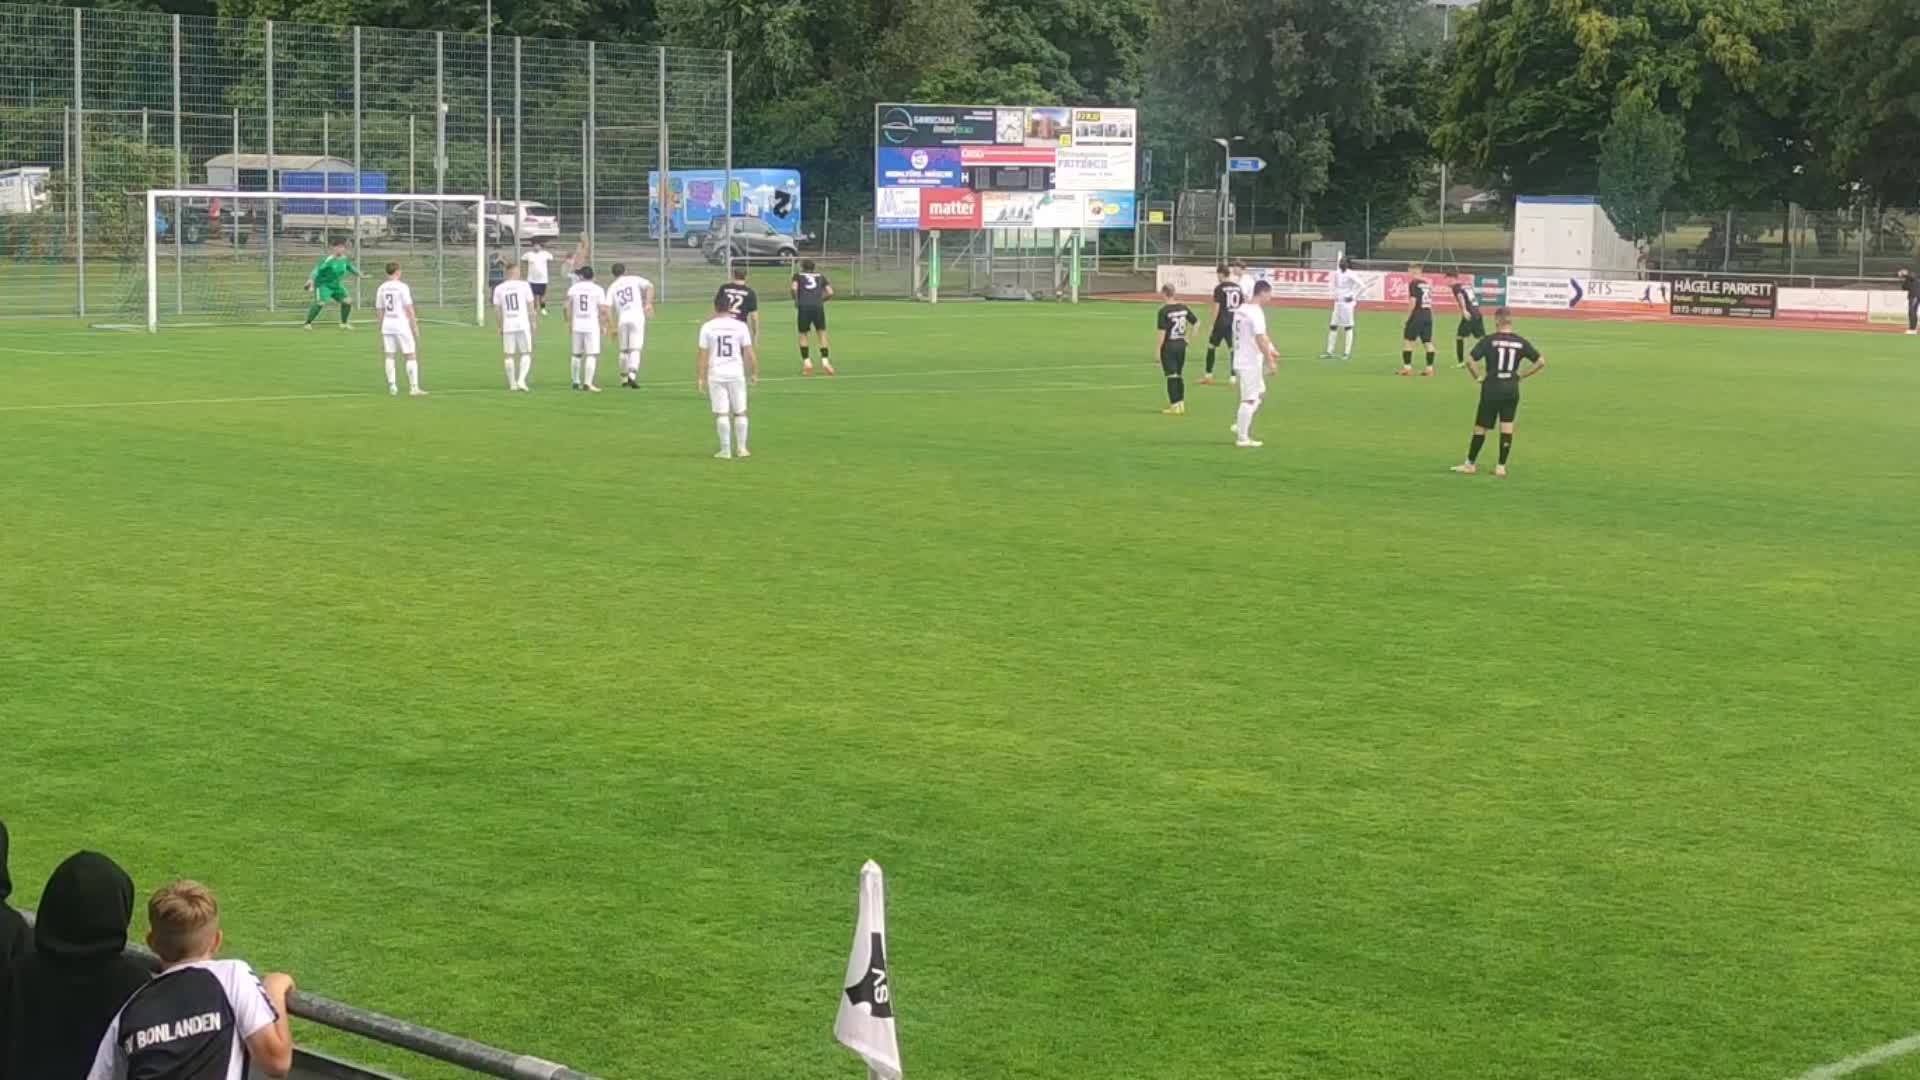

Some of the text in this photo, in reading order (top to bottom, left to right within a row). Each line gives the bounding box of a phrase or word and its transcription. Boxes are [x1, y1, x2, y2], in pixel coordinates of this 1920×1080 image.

[961, 172, 969, 183] H
[929, 201, 975, 215] matter
[806, 275, 817, 289] 3
[1274, 270, 1329, 283] FRITZ
[617, 287, 633, 306] 39
[1587, 281, 1612, 295] RTS
[1722, 282, 1772, 296] PARKETT
[385, 294, 394, 311] 3
[505, 293, 519, 311] 10
[1226, 291, 1240, 309] 10
[717, 335, 732, 357] 15
[1498, 347, 1516, 371] 11
[871, 968, 889, 1005] SV
[137, 1012, 221, 1049] BONLANDEN
